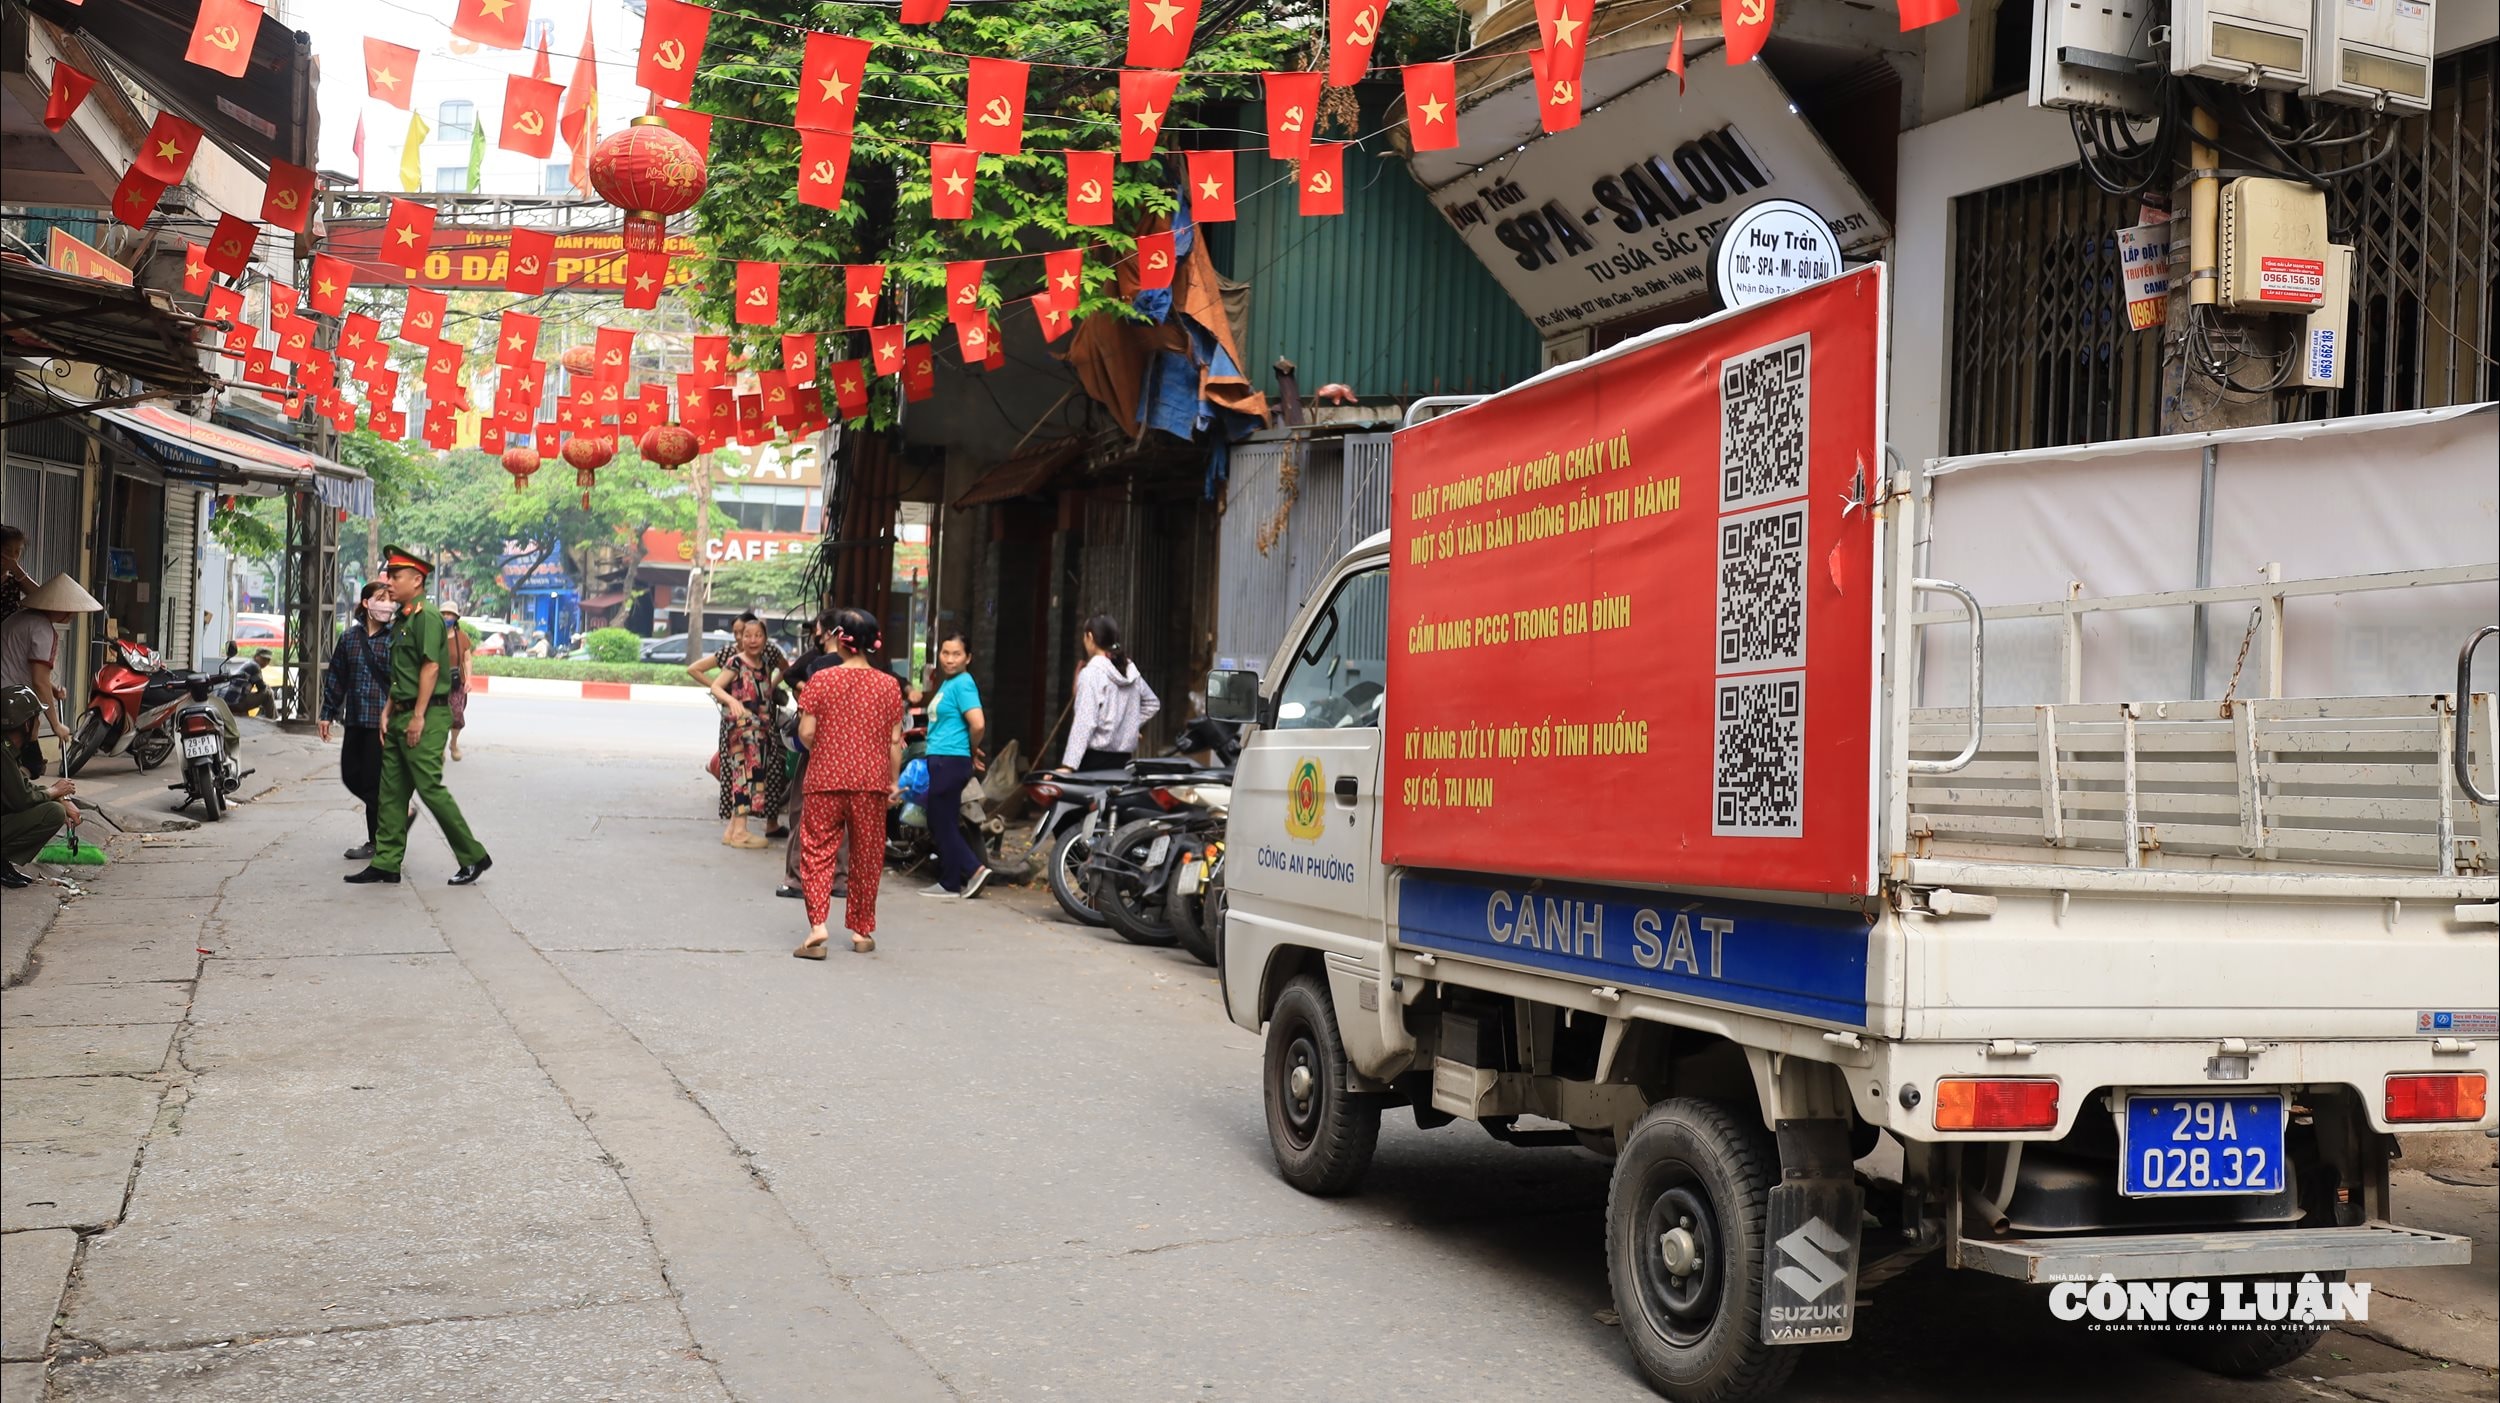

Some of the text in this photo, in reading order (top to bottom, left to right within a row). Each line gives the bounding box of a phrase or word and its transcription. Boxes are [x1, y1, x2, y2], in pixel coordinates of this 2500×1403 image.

[1585, 260, 1616, 283] TU
[1612, 243, 1654, 275] SỬA
[1652, 227, 1698, 261] SẮC
[1750, 228, 1817, 252] Huy Trần
[461, 249, 509, 282] DÂ
[1736, 252, 1750, 274] TÓC
[1757, 256, 1774, 276] SPA
[1781, 258, 1791, 278] MI
[1798, 256, 1811, 283] GỘI
[1813, 255, 1829, 280] ĐẦU
[2263, 273, 2321, 286] 0966.156.158
[1611, 292, 1633, 306] Cao
[1632, 285, 1648, 298] Ba
[1669, 273, 1687, 287] Hà
[1736, 283, 1756, 295] Nhận
[1758, 283, 1774, 295] Đào
[2144, 280, 2169, 295] CAME
[1411, 428, 1631, 523] LUẬT PHÒNG CHÁY CHỮA CHÁY VÀ
[1410, 476, 1681, 568] MỘT SỐ VĂN BẢN HƯỚNG DẪN THI HÀNH
[1437, 619, 1471, 651] NANG
[1474, 613, 1509, 646] PCCC
[1513, 606, 1559, 642] TRONG
[1563, 602, 1588, 636] GIA
[1592, 591, 1631, 632] ĐÌNH
[1404, 709, 1648, 765] KỸ NĂNG XỬ LÝ MỘT SỐ TÌNH HUỐNG
[1403, 767, 1493, 813] SỰ CỐ, TAI NẠN
[1258, 845, 1355, 883] CÔNG AN PHƯỜNG
[1632, 902, 1734, 979] SÁT
[2172, 1102, 2237, 1141] 29A
[2143, 1147, 2266, 1188] 028.32
[1770, 1304, 1849, 1322] SUZUKI
